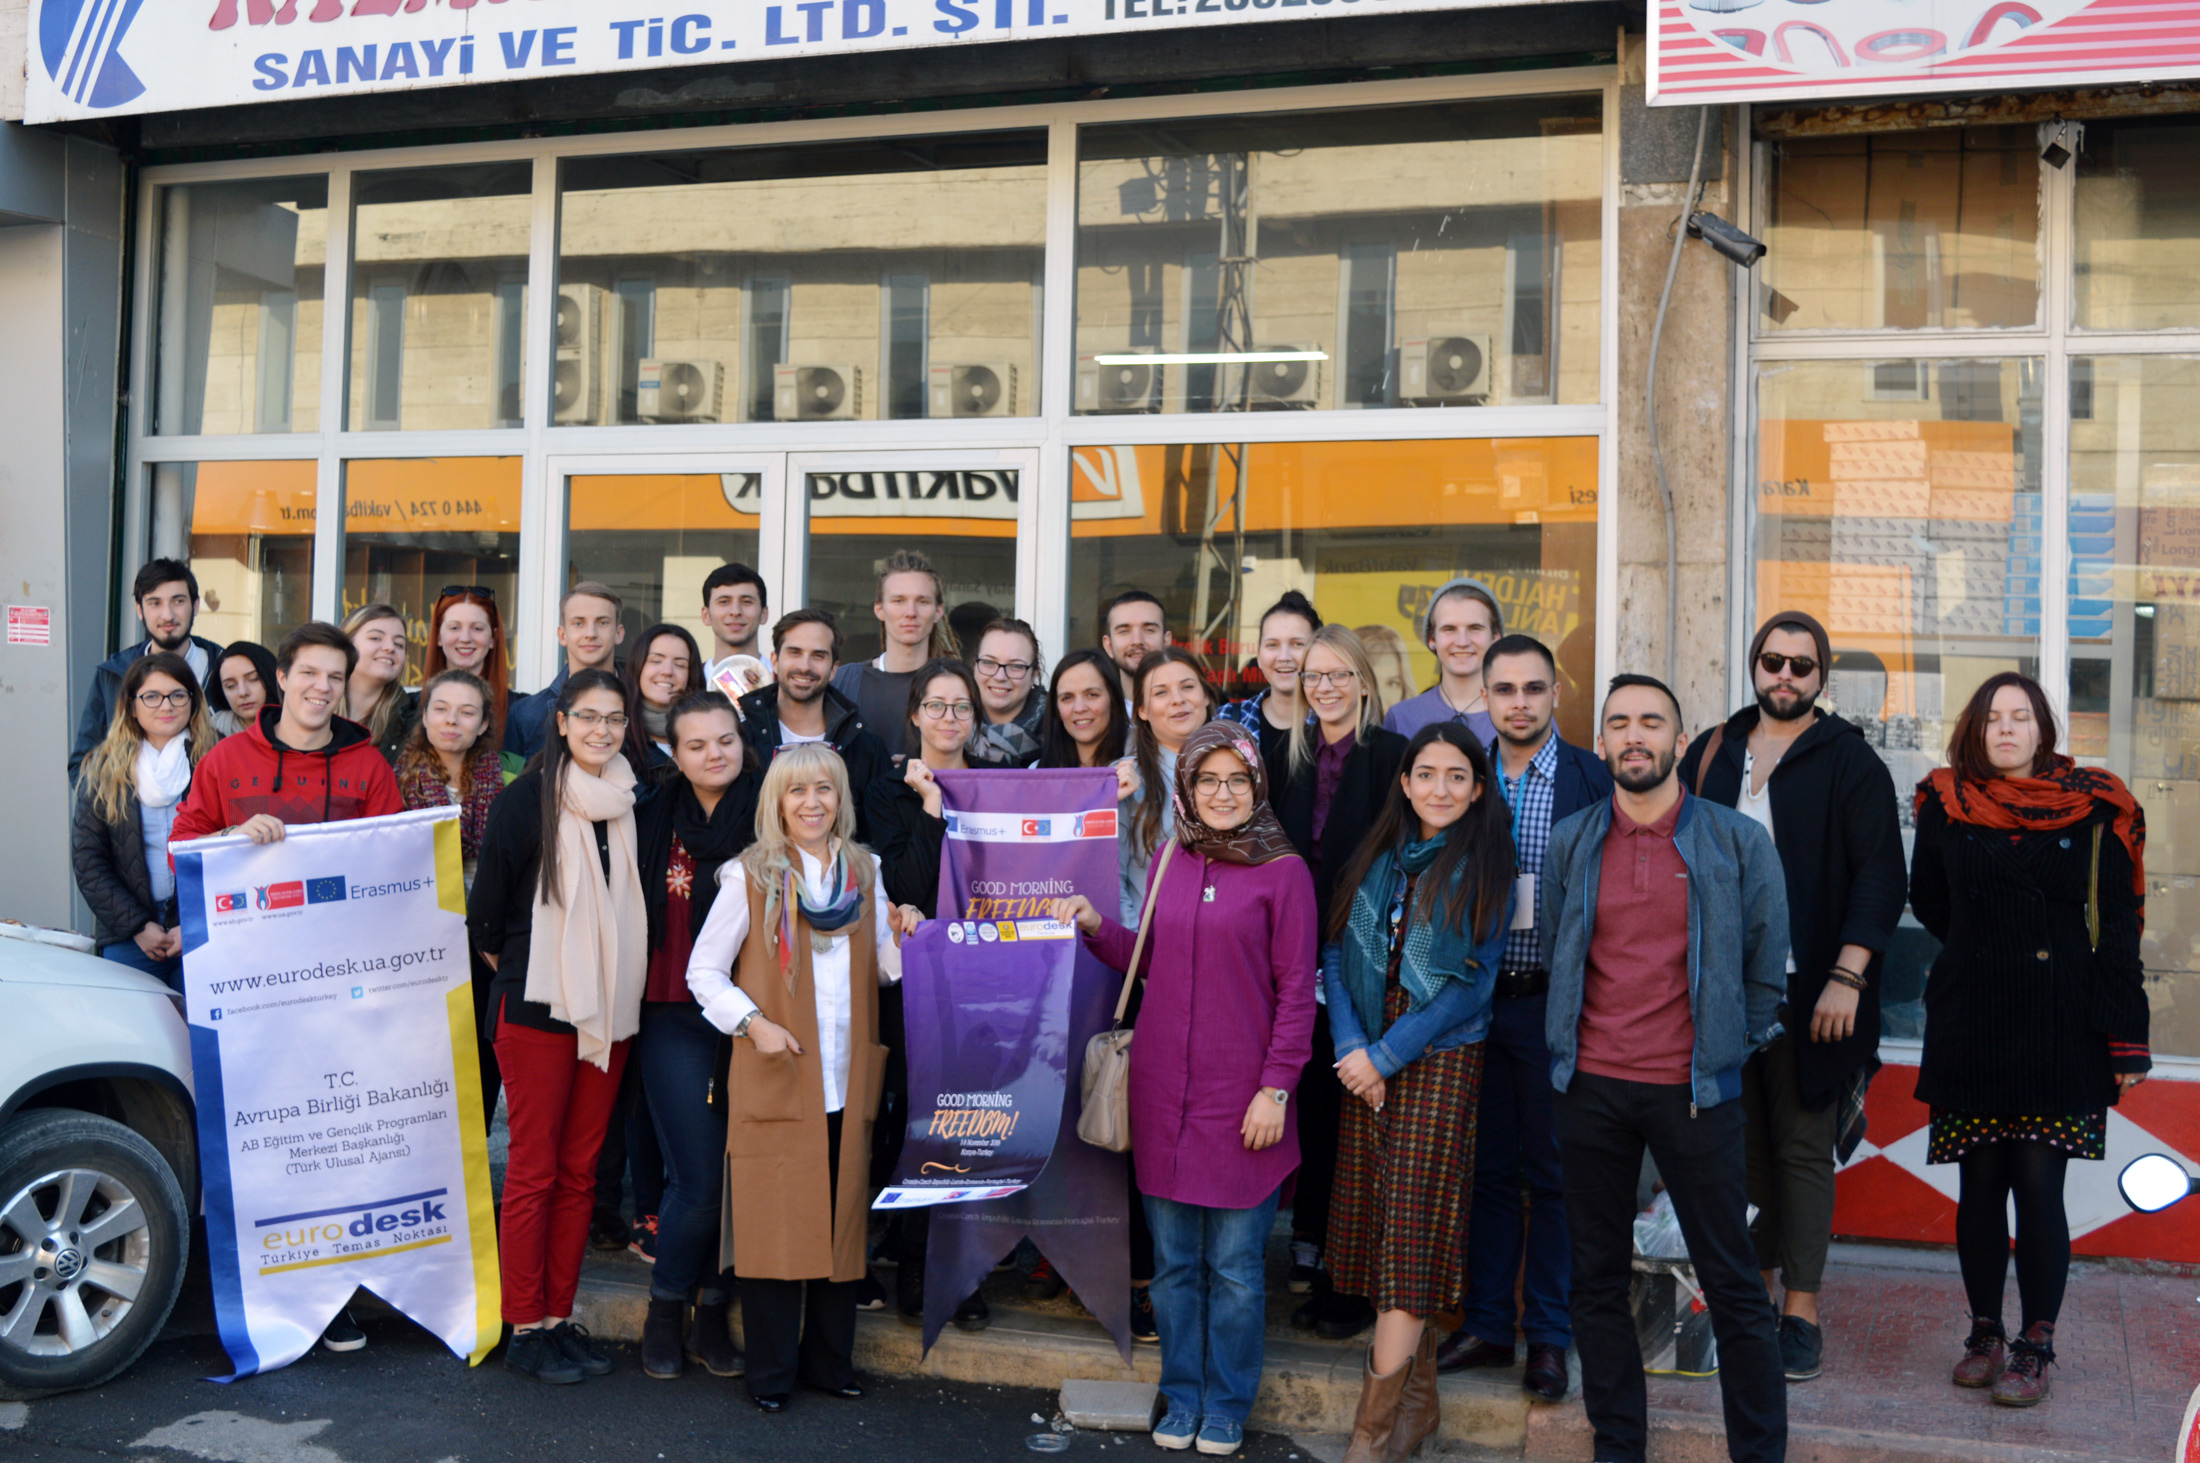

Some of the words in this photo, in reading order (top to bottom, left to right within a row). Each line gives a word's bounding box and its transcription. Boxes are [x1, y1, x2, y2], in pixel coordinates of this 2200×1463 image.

[498, 26, 577, 69] VE
[765, 0, 908, 46] LTD.
[230, 776, 368, 791] GEUINE
[960, 824, 1006, 836] Erasmus+
[351, 876, 434, 899] Erasmus+
[971, 879, 1006, 895] GOOD
[210, 946, 447, 995] www.eurodesk.ua.gov.tr
[324, 1071, 359, 1089] T.C.
[233, 1105, 301, 1127] Avrupa
[307, 1094, 362, 1115] Birliği
[367, 1079, 450, 1107] Bakanlığı
[936, 1093, 965, 1108] GOOD
[240, 1138, 260, 1152] AB
[263, 1132, 305, 1150] Eğitim
[308, 1130, 323, 1141] ve
[326, 1121, 373, 1141] Gençlik
[377, 1109, 448, 1131] Programları
[928, 1108, 1020, 1141] FREEDOM!
[285, 1160, 321, 1176] (Türk
[325, 1154, 365, 1169] Ulusal
[369, 1144, 411, 1165] Ajansı)
[289, 1143, 338, 1159] Merkezi
[341, 1133, 405, 1152] Başkanlığı
[263, 1199, 447, 1251] eurodesk
[260, 1247, 320, 1265] Türkiye
[332, 1238, 381, 1255] Temas
[392, 1224, 448, 1244] Noktası
